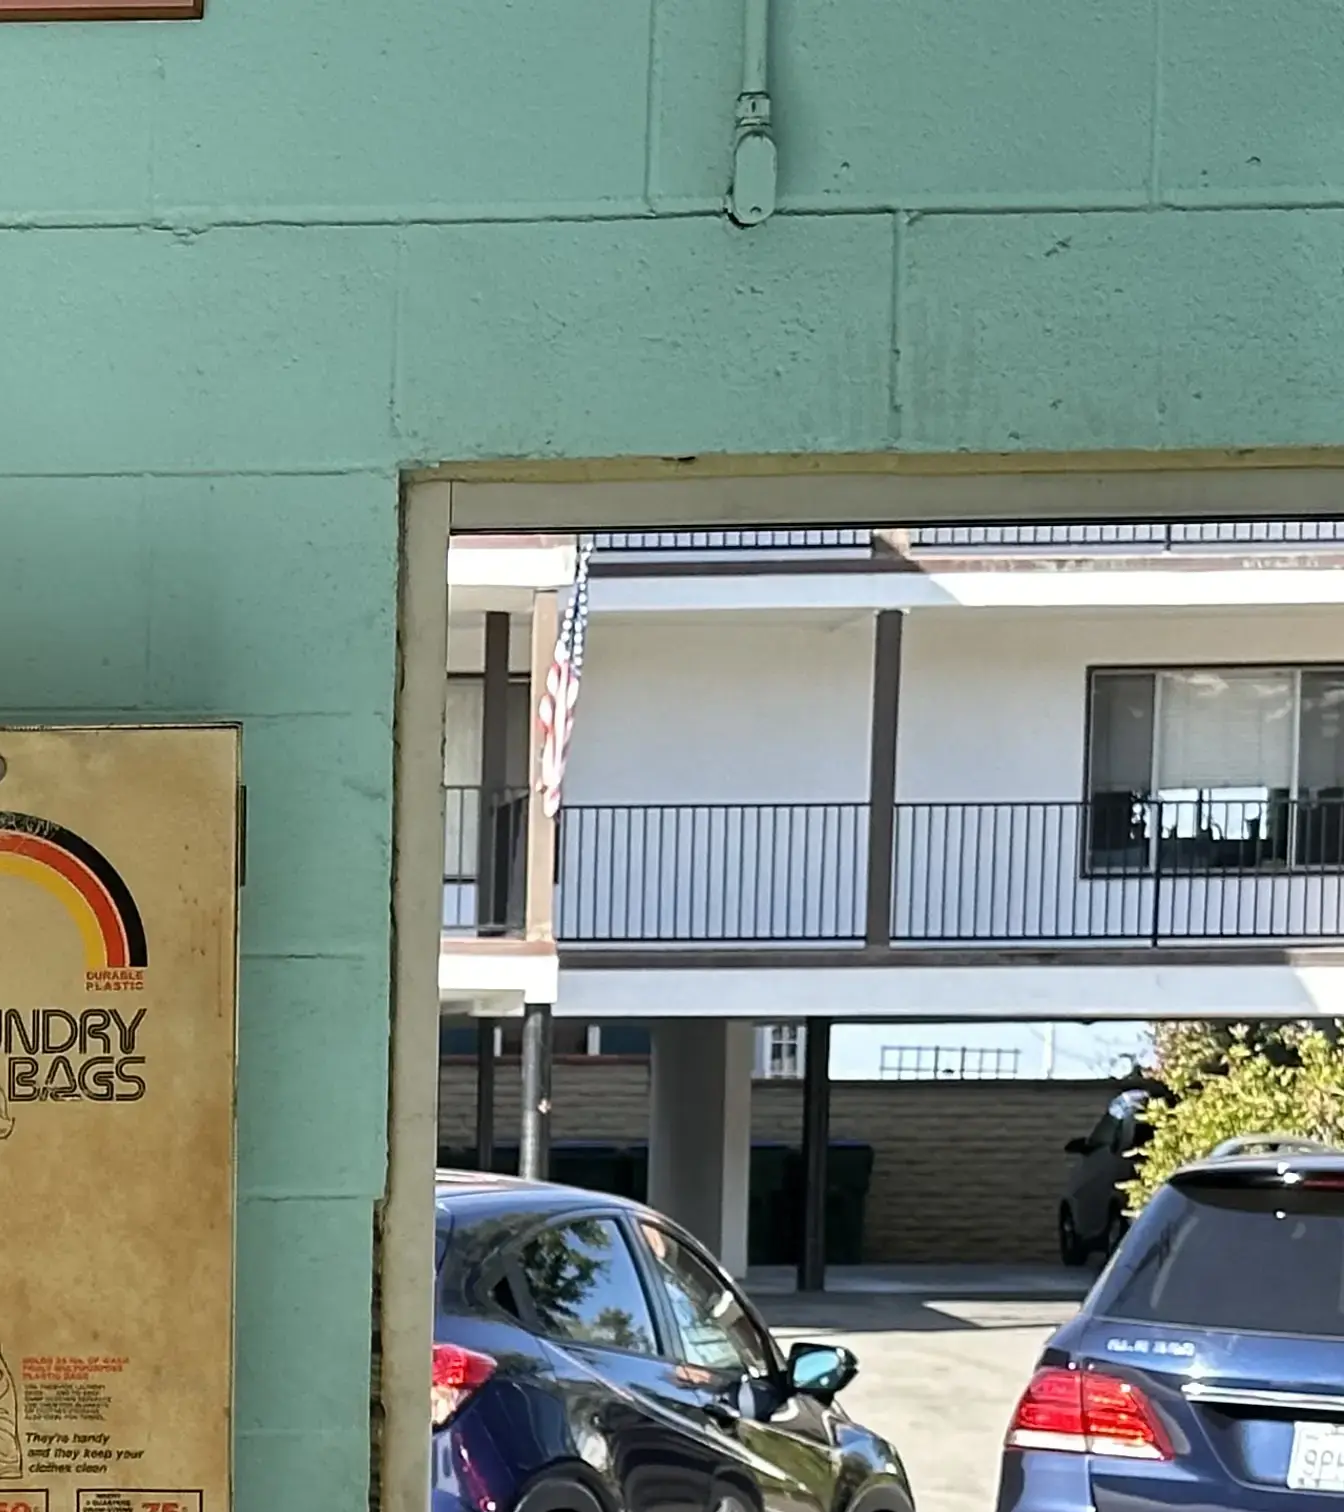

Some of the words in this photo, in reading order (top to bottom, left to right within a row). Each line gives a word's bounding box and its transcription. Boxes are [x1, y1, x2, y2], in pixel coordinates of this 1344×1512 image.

[85, 970, 145, 981] DURABLE
[85, 981, 145, 991] PLASTIC
[7, 1055, 147, 1102] BAGS
[25, 1432, 70, 1445] They're
[72, 1432, 111, 1446] handy
[27, 1448, 51, 1458] and
[54, 1448, 80, 1460] they
[83, 1448, 113, 1460] keep
[116, 1449, 145, 1460] your
[28, 1463, 72, 1473] clothes
[75, 1463, 108, 1473] clean
